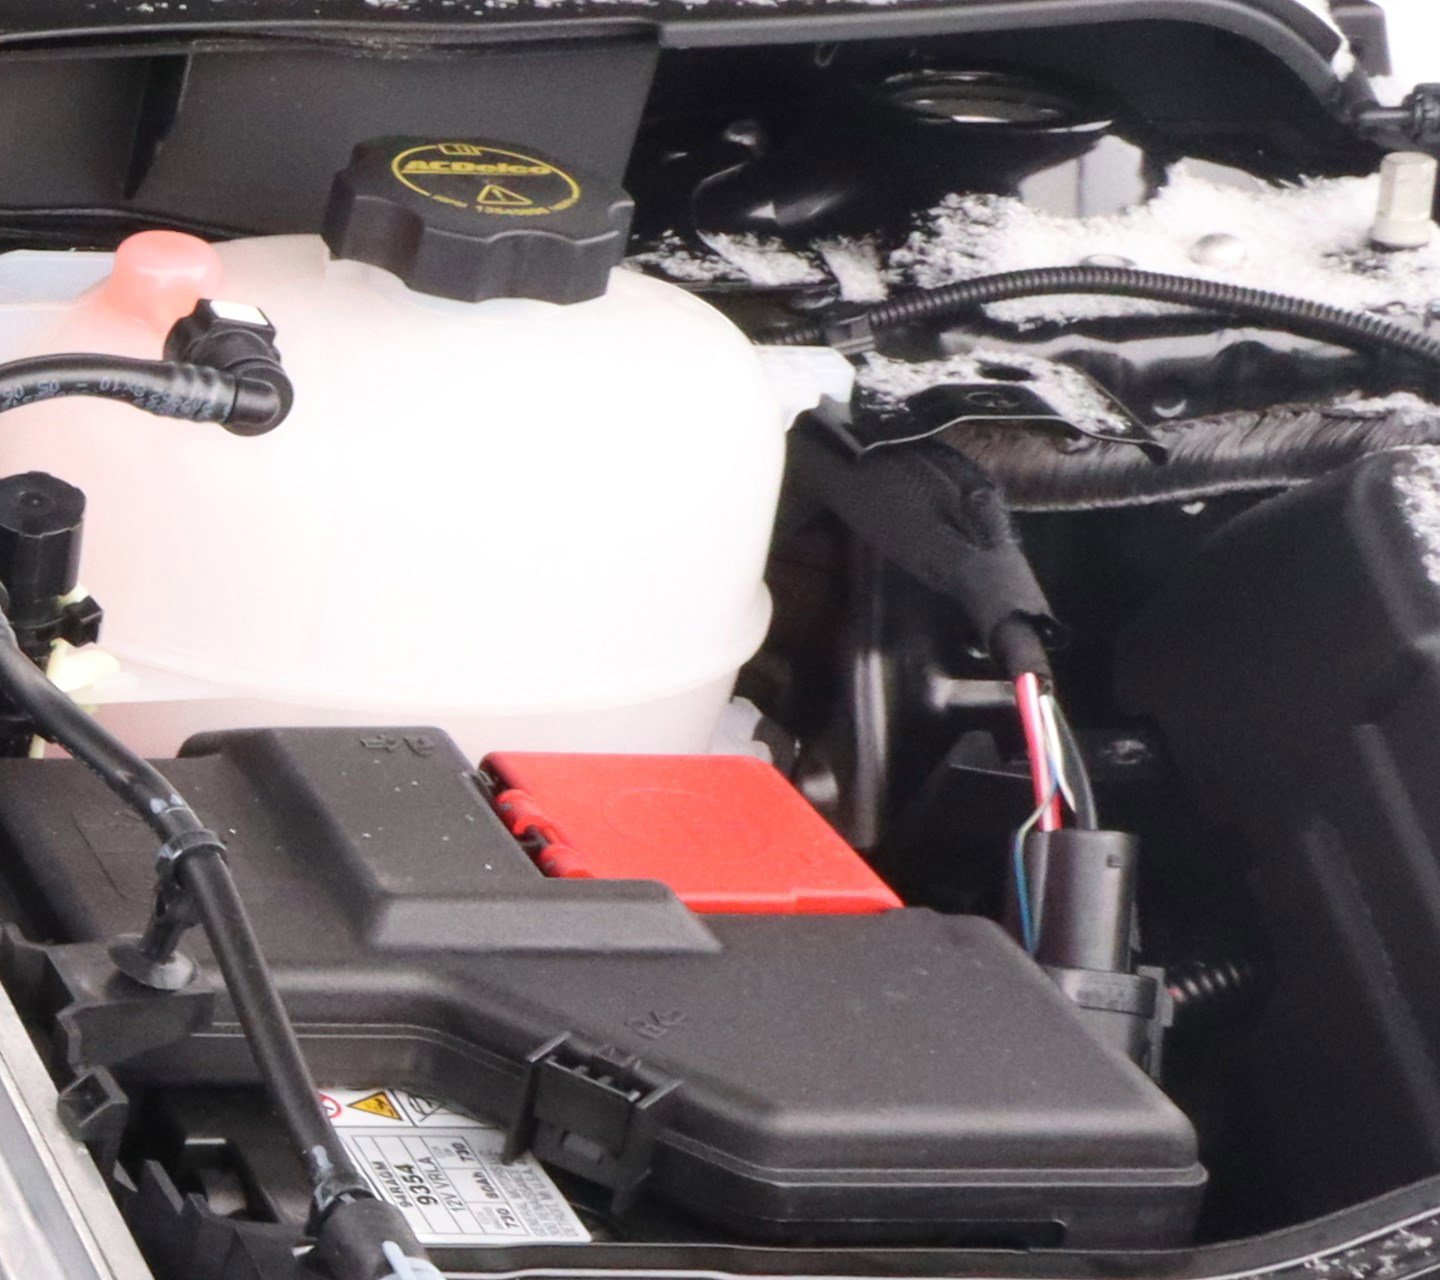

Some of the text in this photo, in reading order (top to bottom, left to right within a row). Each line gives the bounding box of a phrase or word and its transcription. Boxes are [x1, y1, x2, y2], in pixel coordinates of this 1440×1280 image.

[401, 159, 554, 176] ACDelco
[450, 1142, 474, 1161] 730
[393, 1164, 439, 1204] 9354
[415, 1156, 466, 1210] 12V VRLA
[470, 1171, 500, 1198] 80Ah
[495, 1208, 519, 1227] 730
